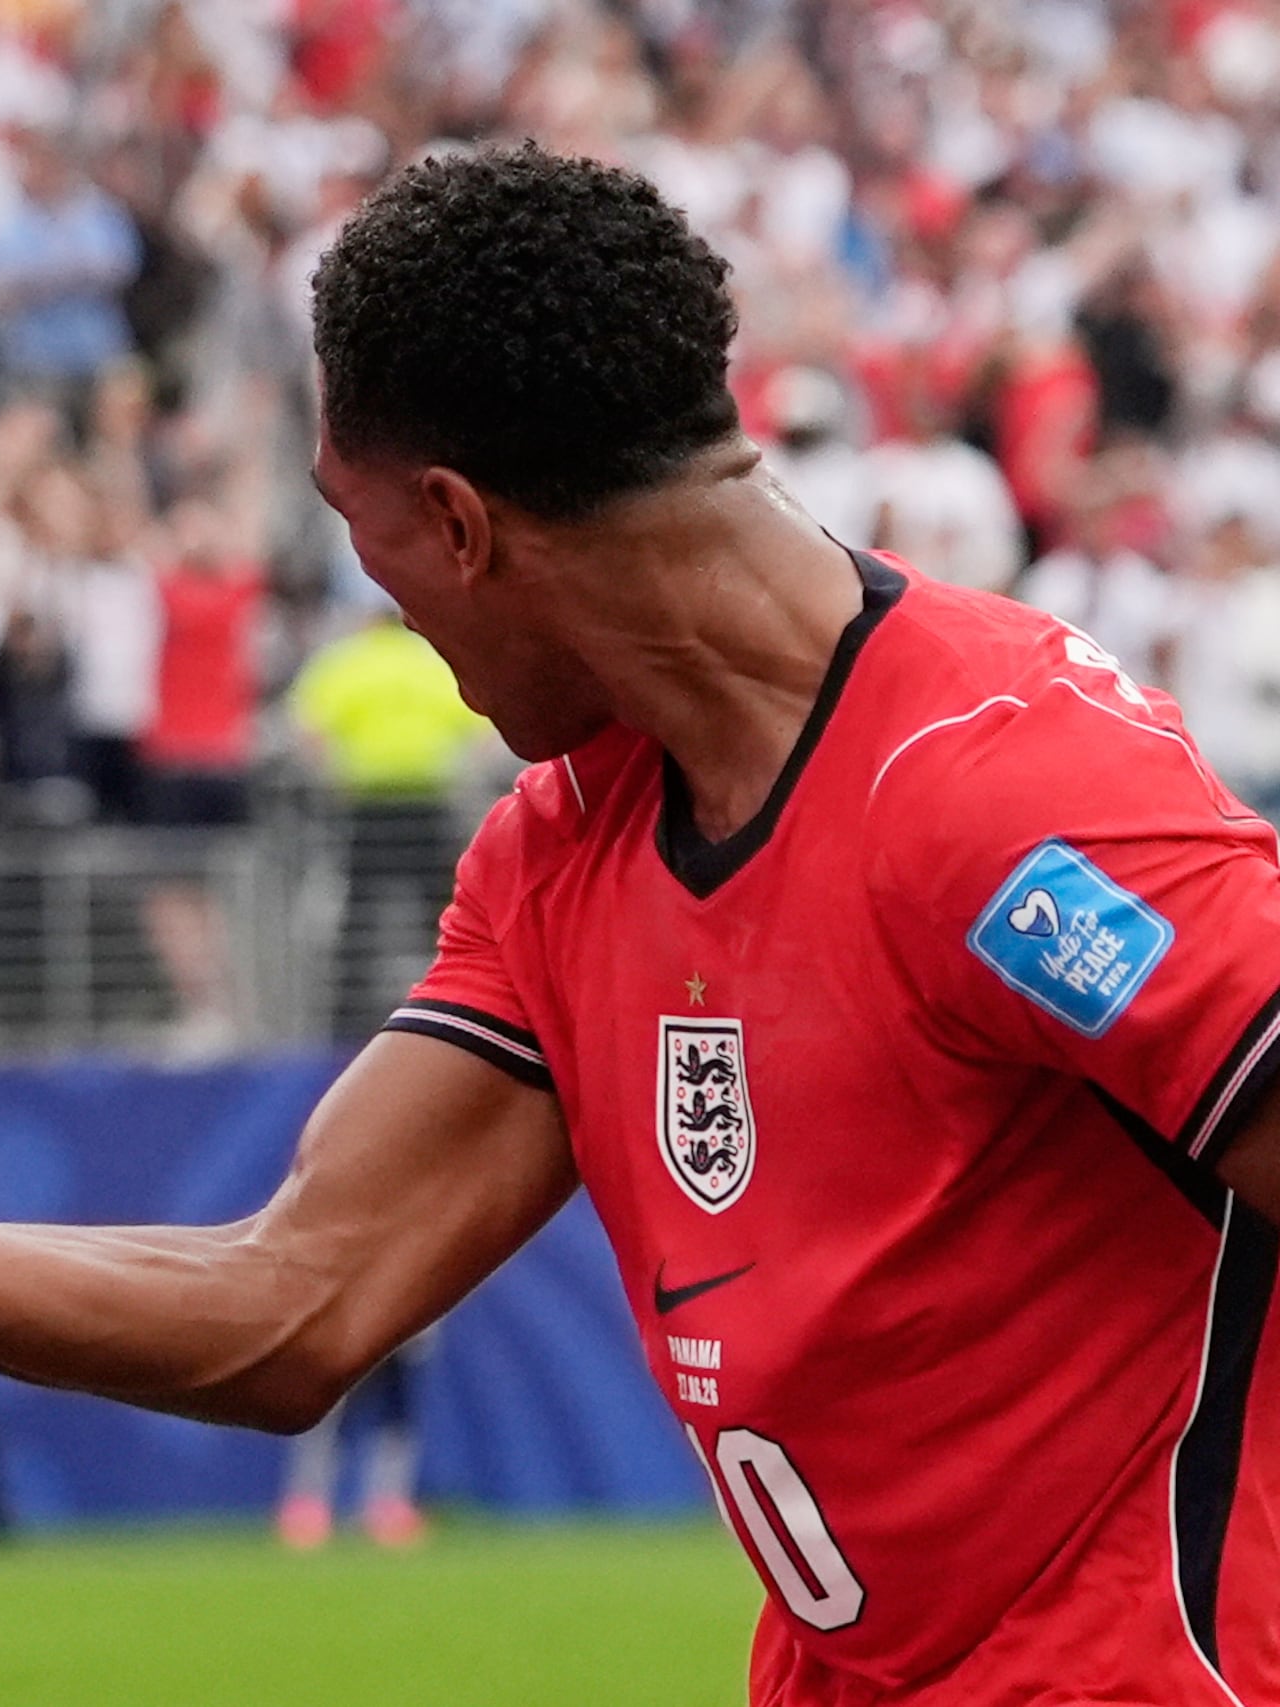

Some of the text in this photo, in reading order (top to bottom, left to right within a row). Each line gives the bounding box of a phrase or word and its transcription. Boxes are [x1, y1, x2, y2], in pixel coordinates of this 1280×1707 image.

[1064, 926, 1125, 995] PEACE
[1098, 961, 1132, 997] FIFA
[667, 1335, 721, 1370] PANAMA
